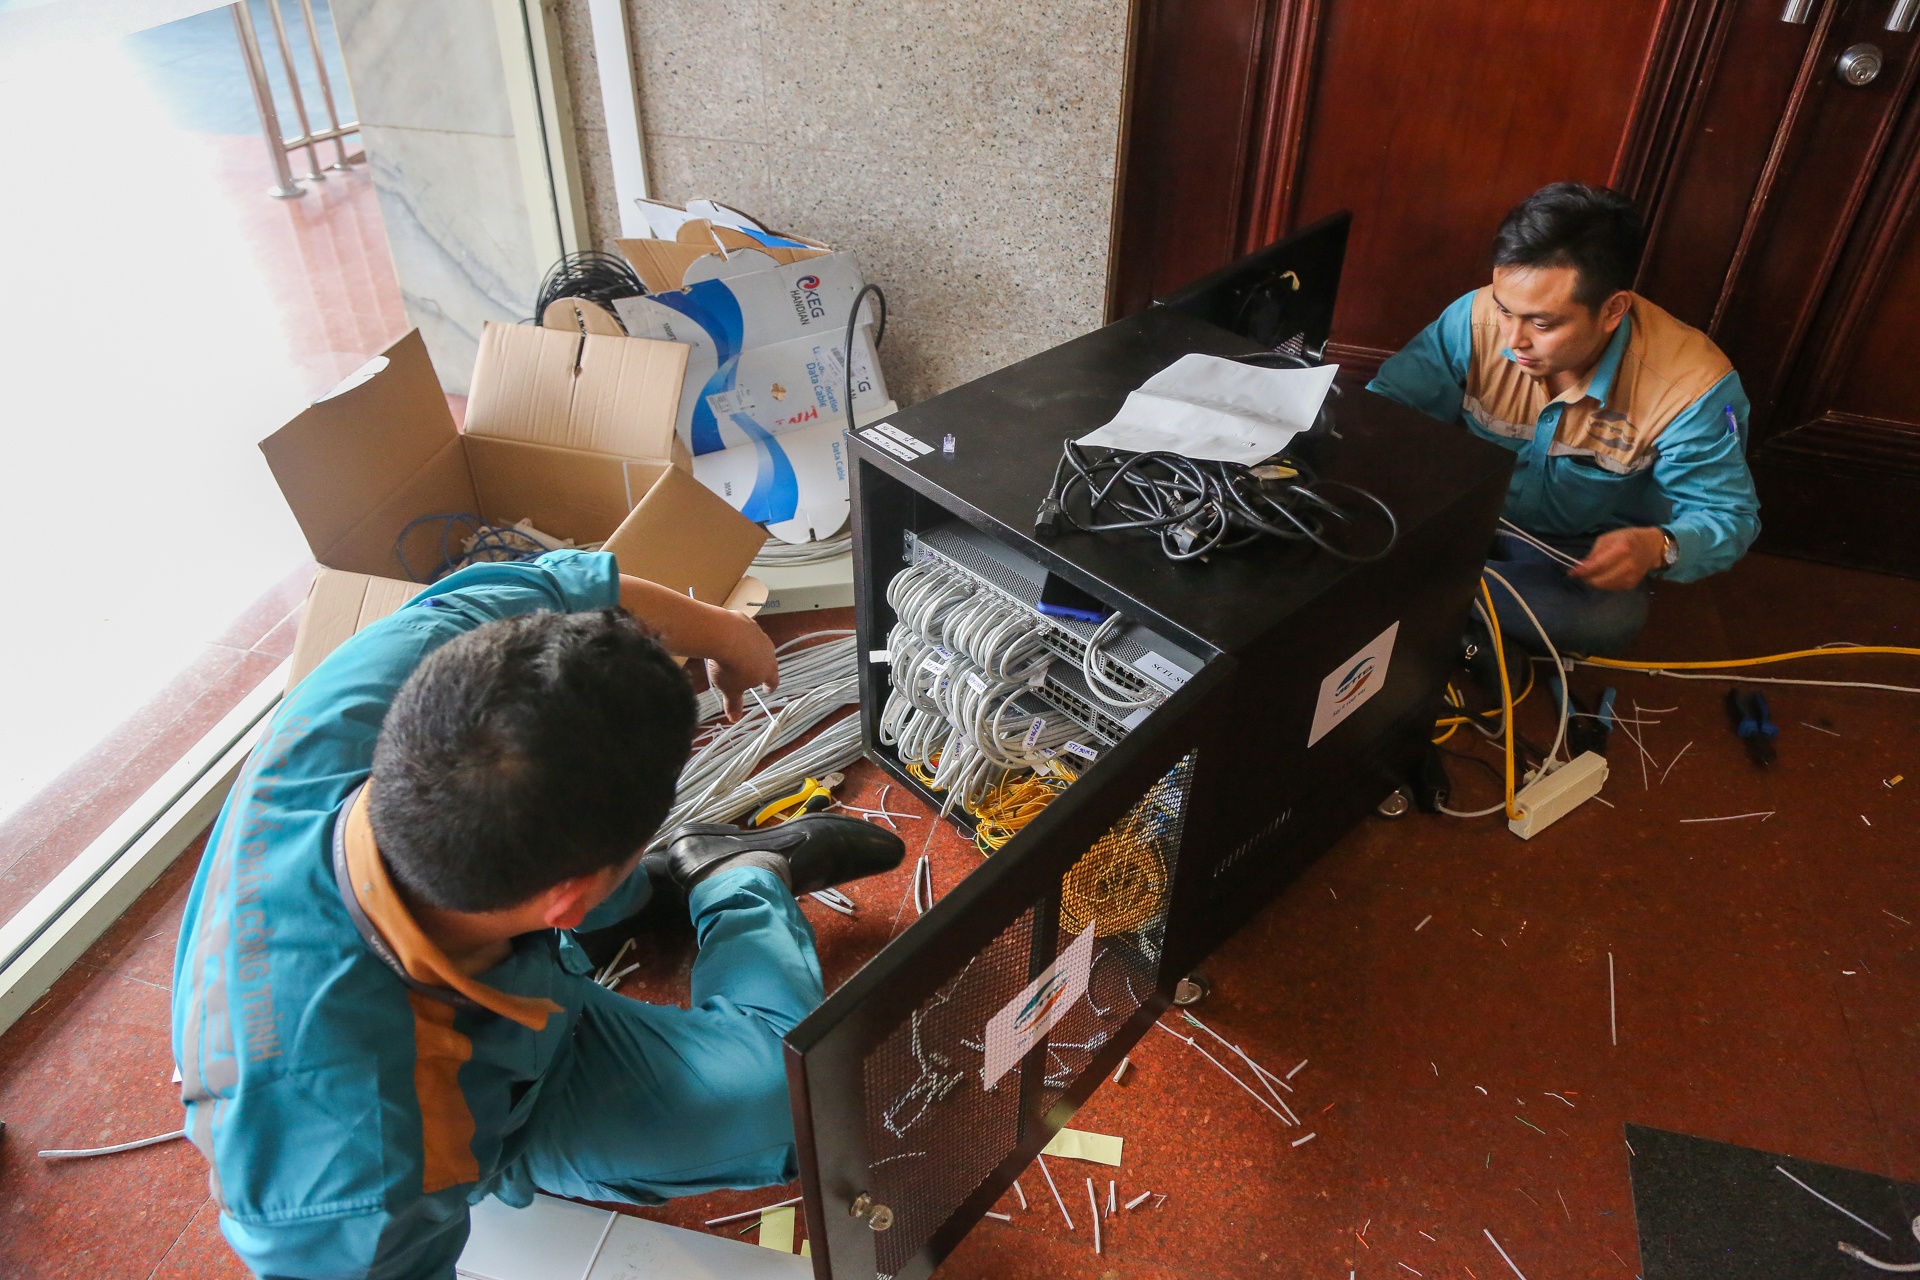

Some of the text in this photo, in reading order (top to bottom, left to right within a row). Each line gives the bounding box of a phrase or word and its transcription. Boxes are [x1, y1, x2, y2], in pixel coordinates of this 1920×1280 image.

[790, 289, 810, 326] HANDIAN
[806, 362, 820, 386] Data
[812, 384, 828, 409] Cable
[831, 441, 845, 482] Data Cable
[235, 912, 274, 983] CÔNG
[239, 987, 283, 1064] TRÌNH
